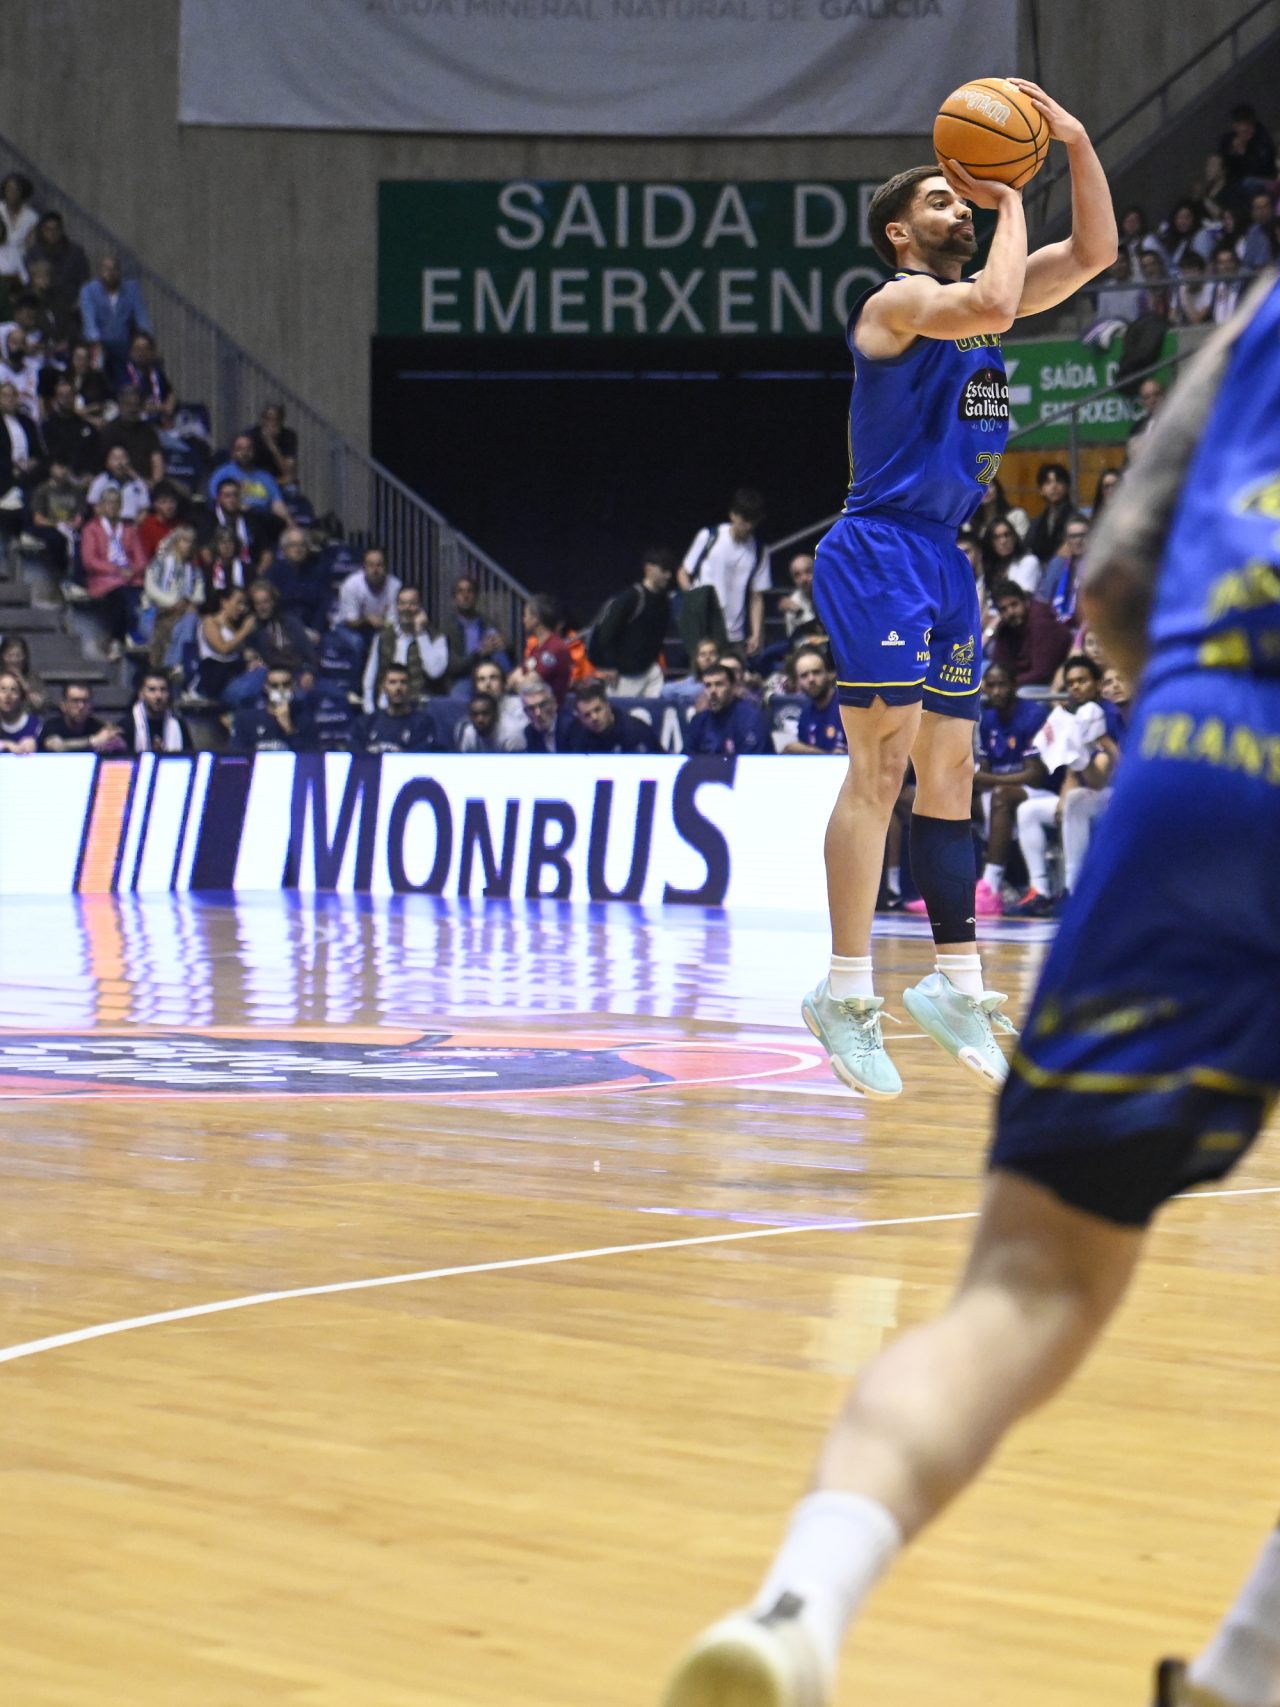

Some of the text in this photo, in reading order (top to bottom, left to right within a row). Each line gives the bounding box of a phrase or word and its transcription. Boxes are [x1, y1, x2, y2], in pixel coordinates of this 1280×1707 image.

[496, 183, 758, 250] SAIDA
[965, 381, 1008, 399] Estrella
[965, 399, 1008, 417] Galicia
[283, 753, 737, 906] MONBUS
